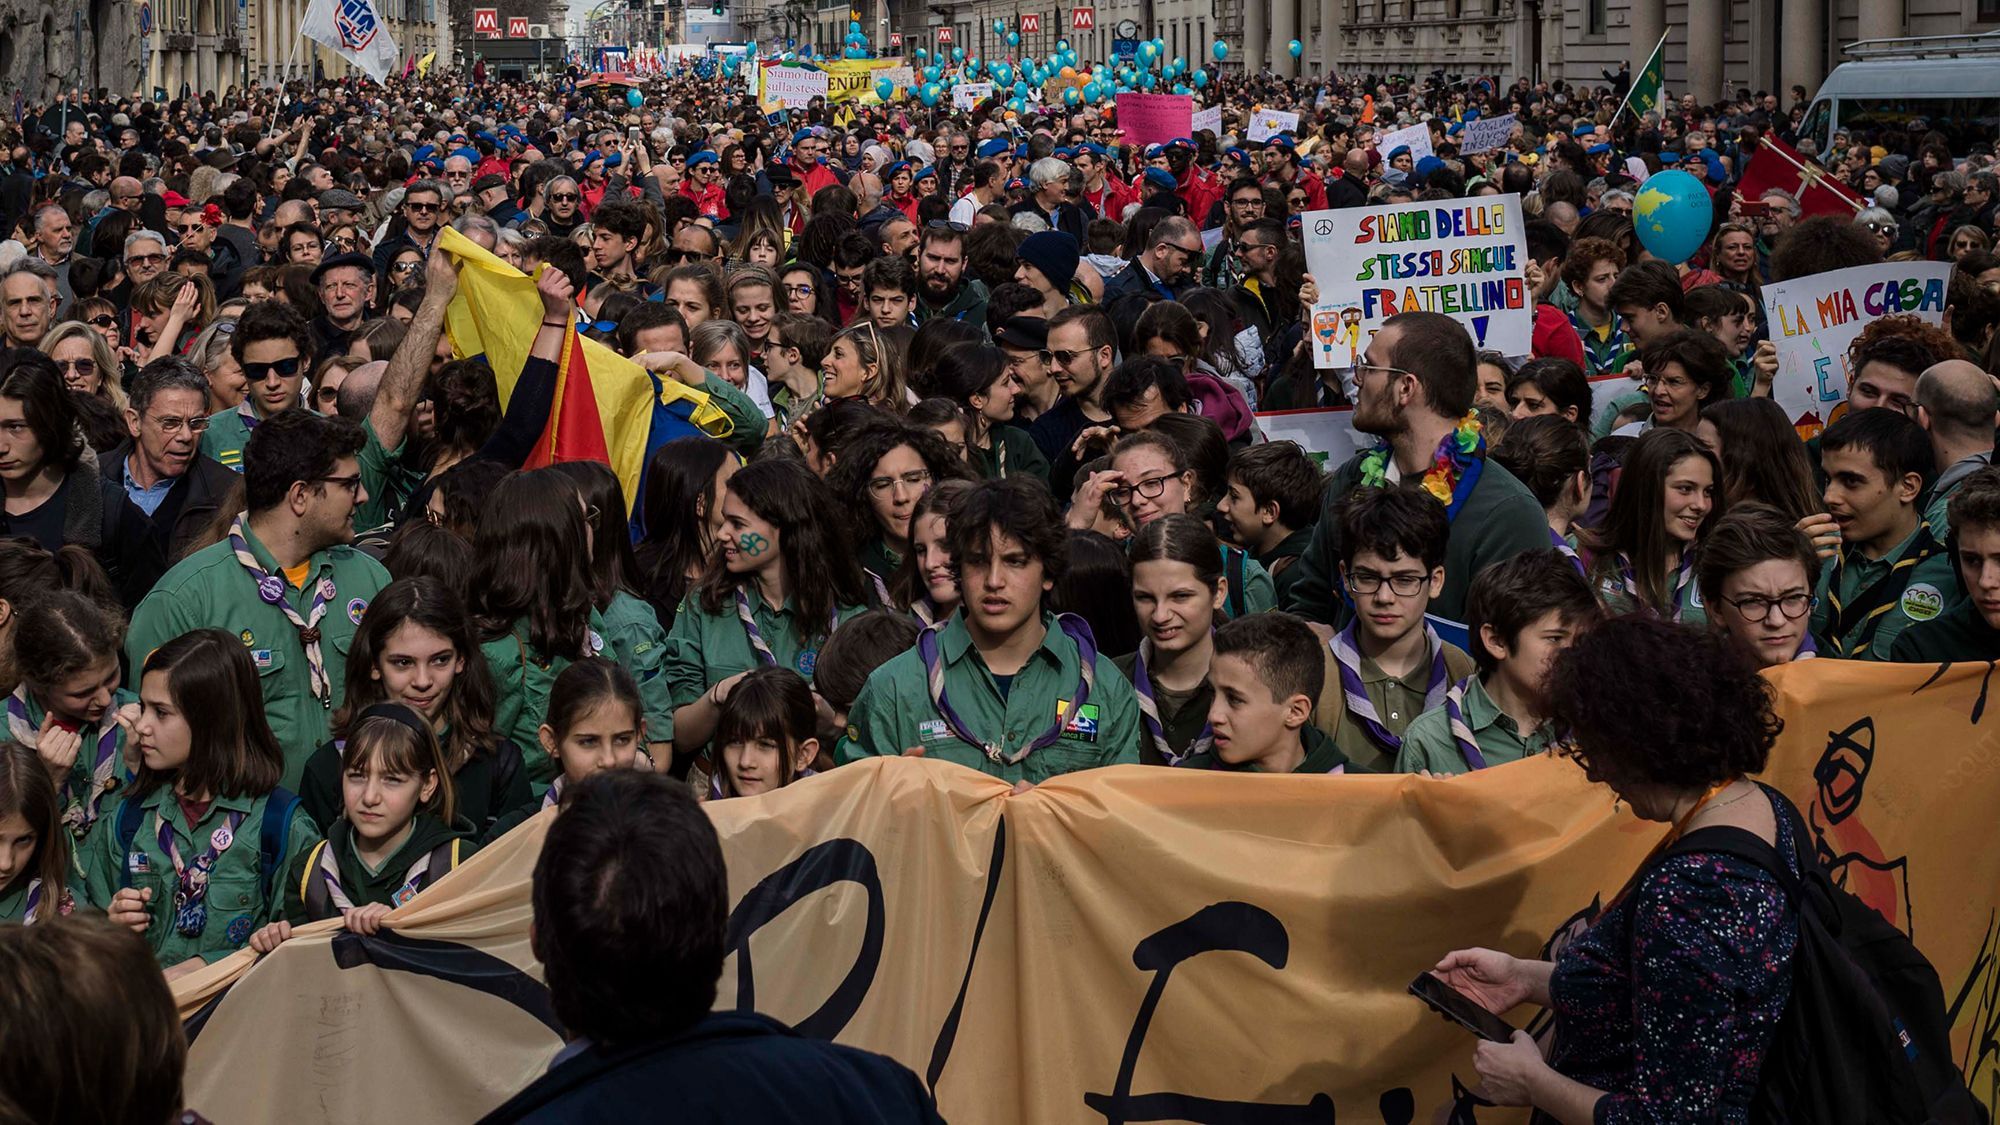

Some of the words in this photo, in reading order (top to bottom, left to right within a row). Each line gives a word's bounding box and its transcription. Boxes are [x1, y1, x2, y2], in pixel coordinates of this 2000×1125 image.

[476, 14, 496, 28] M
[1022, 18, 1038, 30] M
[1074, 11, 1092, 25] M
[511, 22, 526, 34] M
[890, 35, 901, 44] M
[939, 30, 952, 40] M
[767, 68, 801, 79] Siamo
[804, 71, 827, 81] tutti
[766, 82, 792, 92] sulla
[795, 85, 826, 94] stessa
[828, 77, 871, 90] ENUT
[155, 91, 161, 101] P
[1354, 209, 1431, 244] SIAMO
[1435, 204, 1505, 239] DELLO
[1356, 250, 1443, 281] STESSO
[1447, 244, 1516, 275] SANGUE
[1362, 277, 1525, 320] FRATELLINO
[1778, 304, 1810, 337] LA
[1815, 288, 1859, 329] MIA
[1863, 278, 1944, 317] CASA
